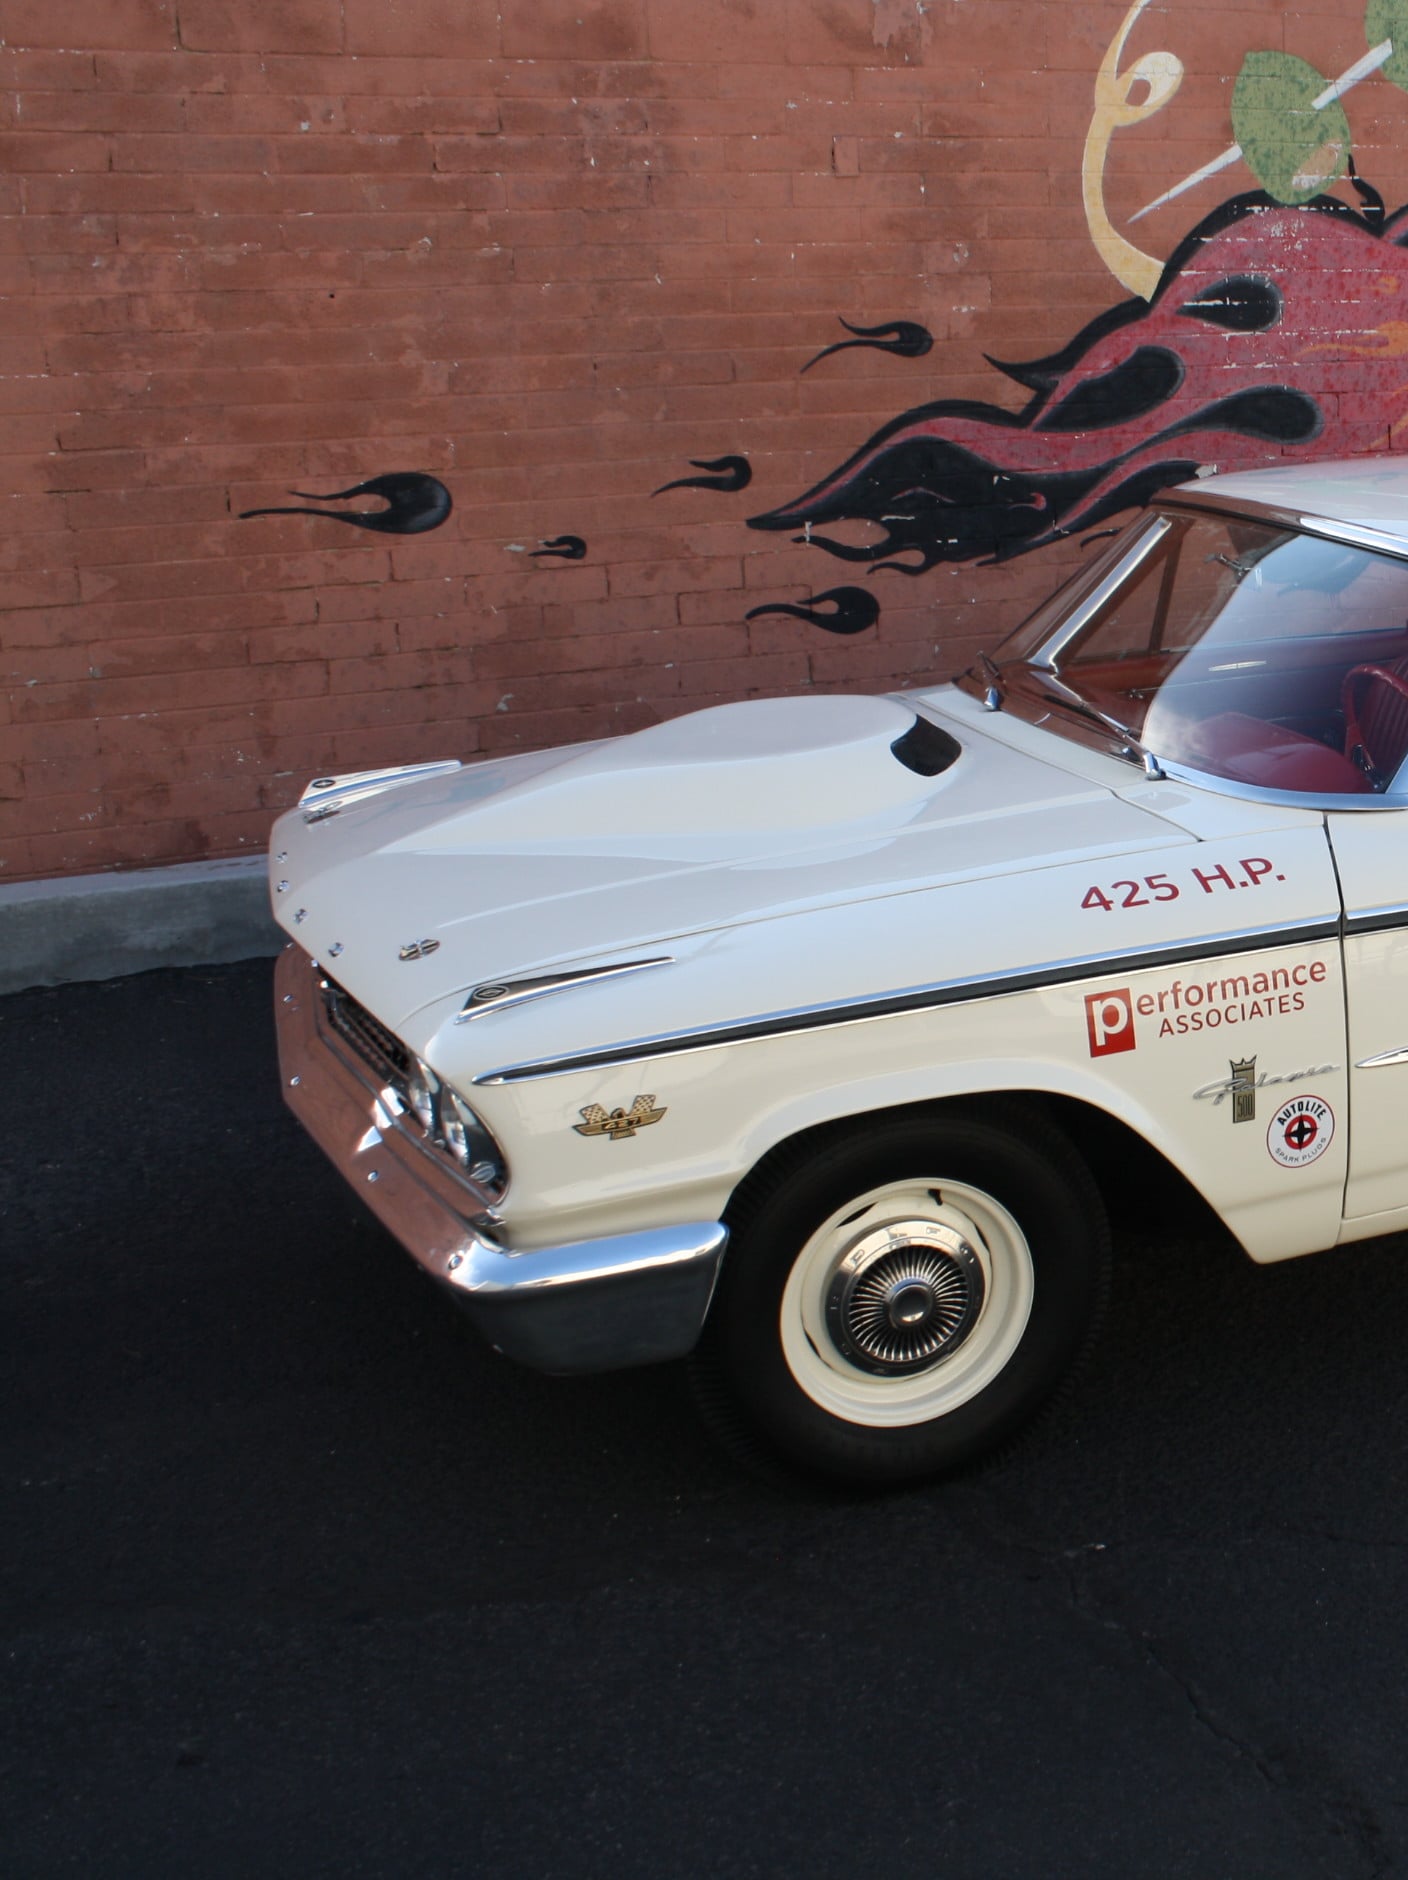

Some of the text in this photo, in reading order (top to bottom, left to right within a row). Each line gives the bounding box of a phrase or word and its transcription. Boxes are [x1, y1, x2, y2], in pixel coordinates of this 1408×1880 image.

[1080, 857, 1286, 911] 425 H.P.
[1159, 992, 1305, 1038] ASSOCIATES
[1277, 1100, 1327, 1126] AUTOLITE
[1275, 1147, 1300, 1163] SPARK
